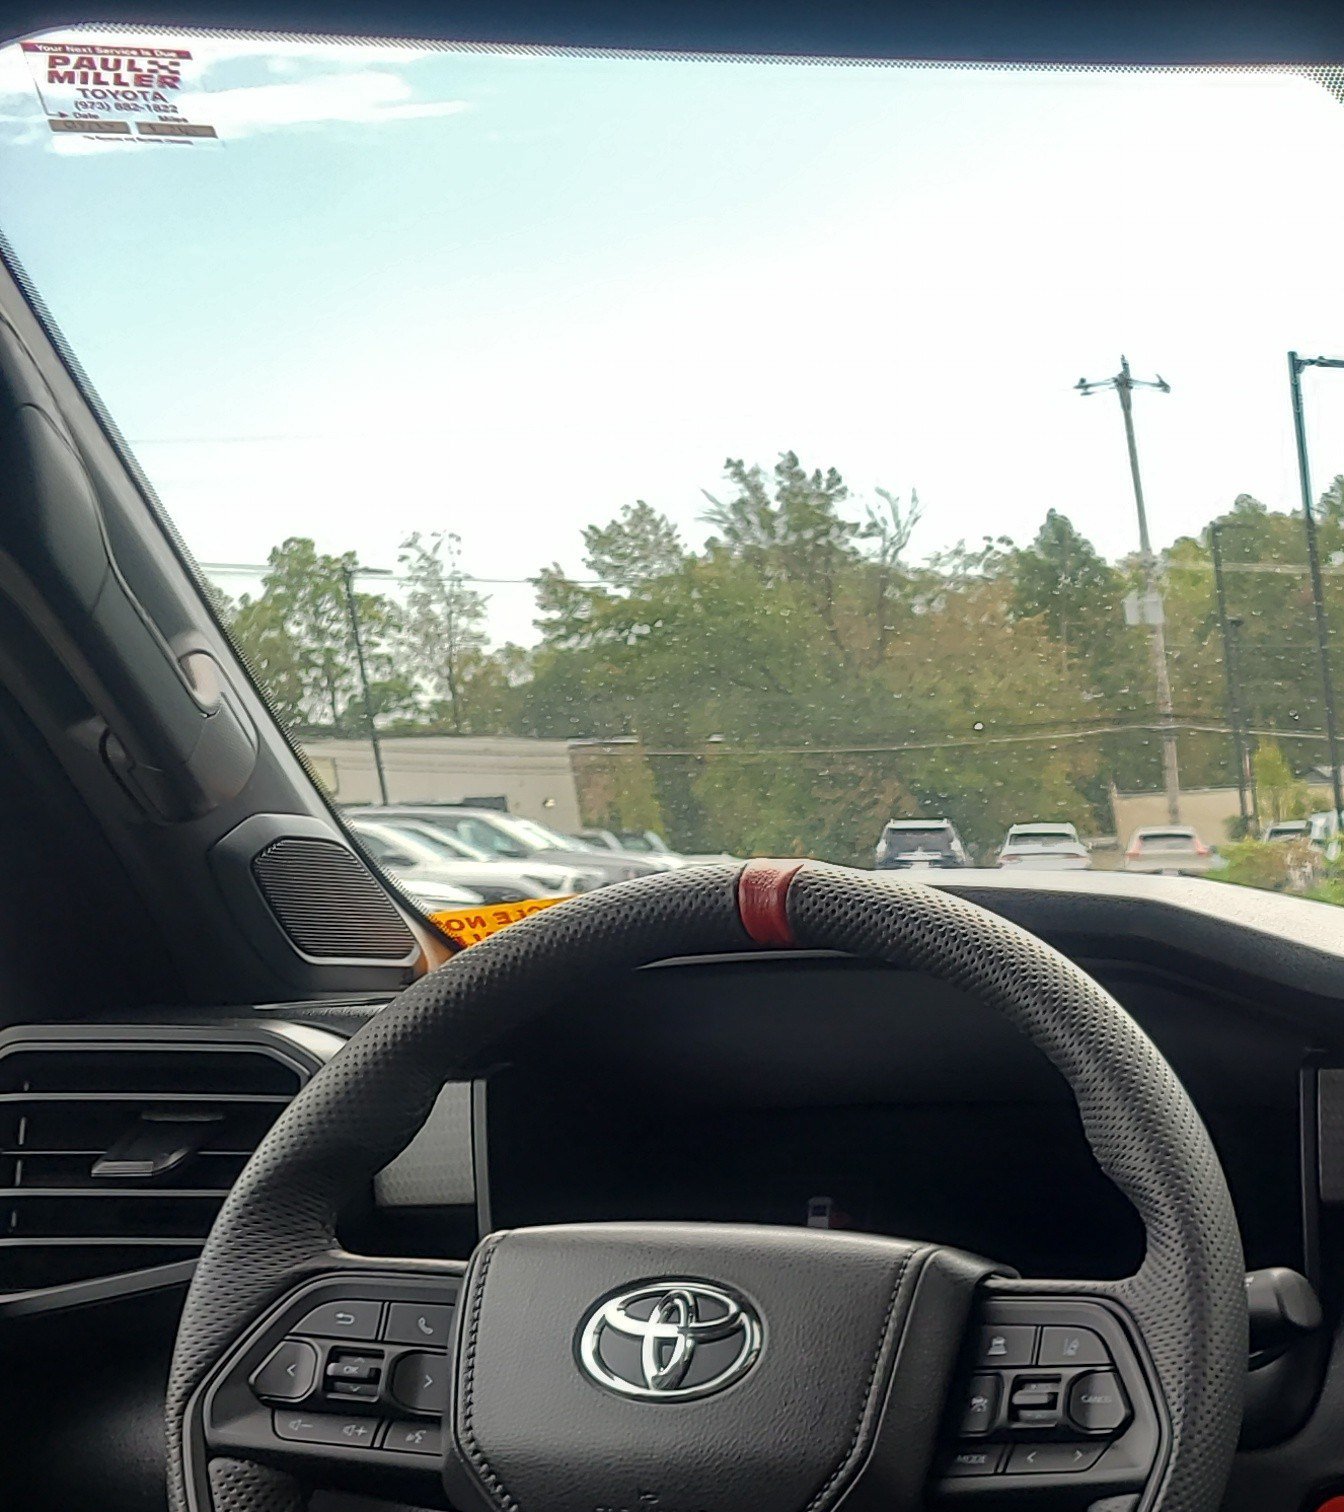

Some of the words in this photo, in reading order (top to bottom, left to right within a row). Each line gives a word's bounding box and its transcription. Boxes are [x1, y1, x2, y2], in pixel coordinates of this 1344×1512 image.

[48, 55, 143, 72] PAUL
[47, 70, 181, 90] MILLER
[76, 88, 169, 103] TOYOTA
[74, 101, 111, 112] (973)
